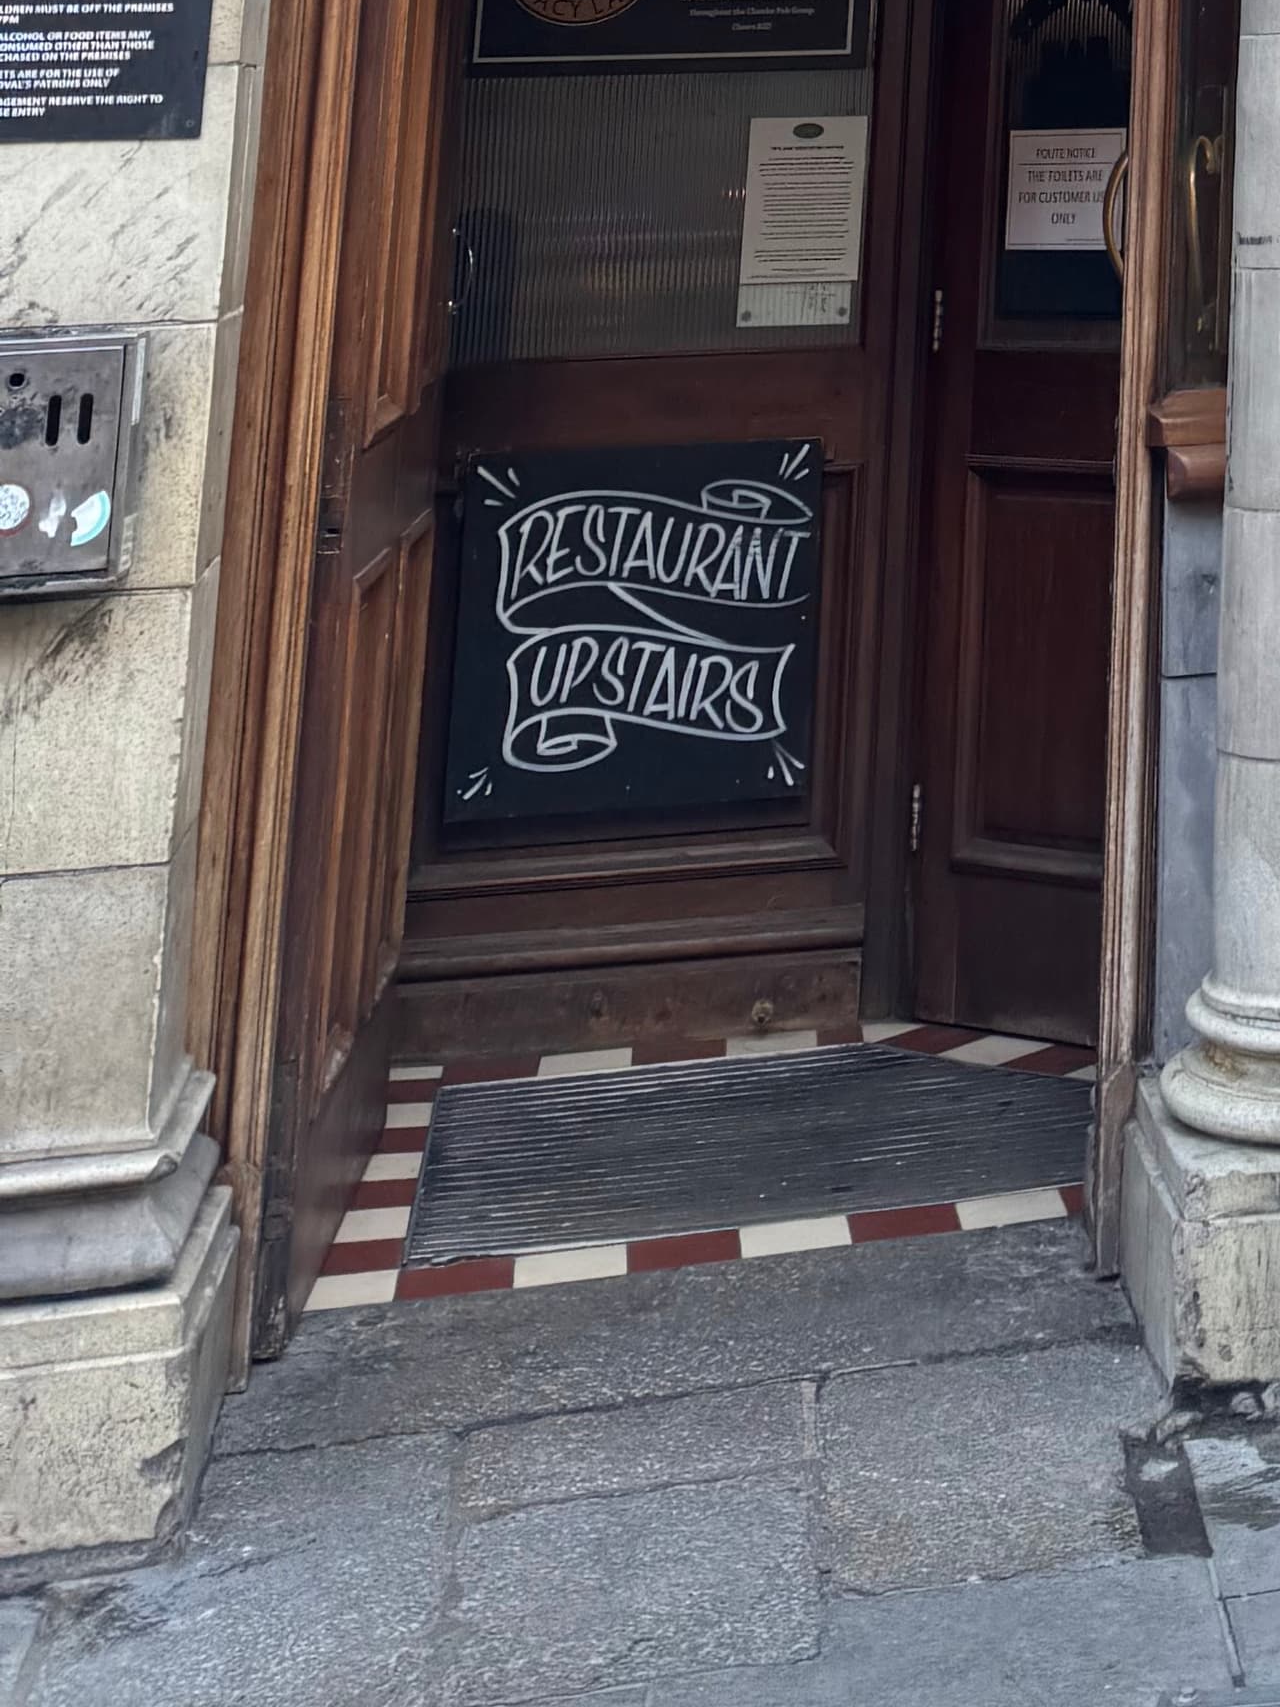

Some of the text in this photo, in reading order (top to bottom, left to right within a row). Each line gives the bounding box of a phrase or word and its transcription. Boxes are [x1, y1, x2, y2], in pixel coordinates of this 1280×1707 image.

[0, 3, 175, 14] LDREN MUST BE OFF THE PREMISES
[47, 32, 63, 41] OR
[64, 31, 95, 41] FOOD
[95, 31, 127, 40] ITEMS
[127, 30, 151, 40] MAY
[0, 40, 155, 52] ONSUMED OTHER THAN THOSE
[0, 50, 131, 62] CHASED ON THE PREMISES
[16, 69, 38, 79] ARE
[39, 69, 61, 79] FOR
[62, 68, 82, 78] THE
[83, 68, 105, 78] USE
[105, 67, 120, 77] OF
[33, 79, 82, 89] PATRONS
[82, 78, 111, 88] ONLY
[0, 94, 164, 107] AGEMENT RESERVE THE RIGHT TO
[11, 107, 46, 118] ENTRY
[1036, 147, 1096, 160] POLITE NOTICE
[1028, 169, 1104, 183] THE TOILETS ARE
[1018, 190, 1105, 204] FOR CUSTOMER US
[1051, 212, 1077, 225] ONLY
[510, 504, 812, 601] RESTAURANT
[529, 636, 764, 734] UPSTAIRS
